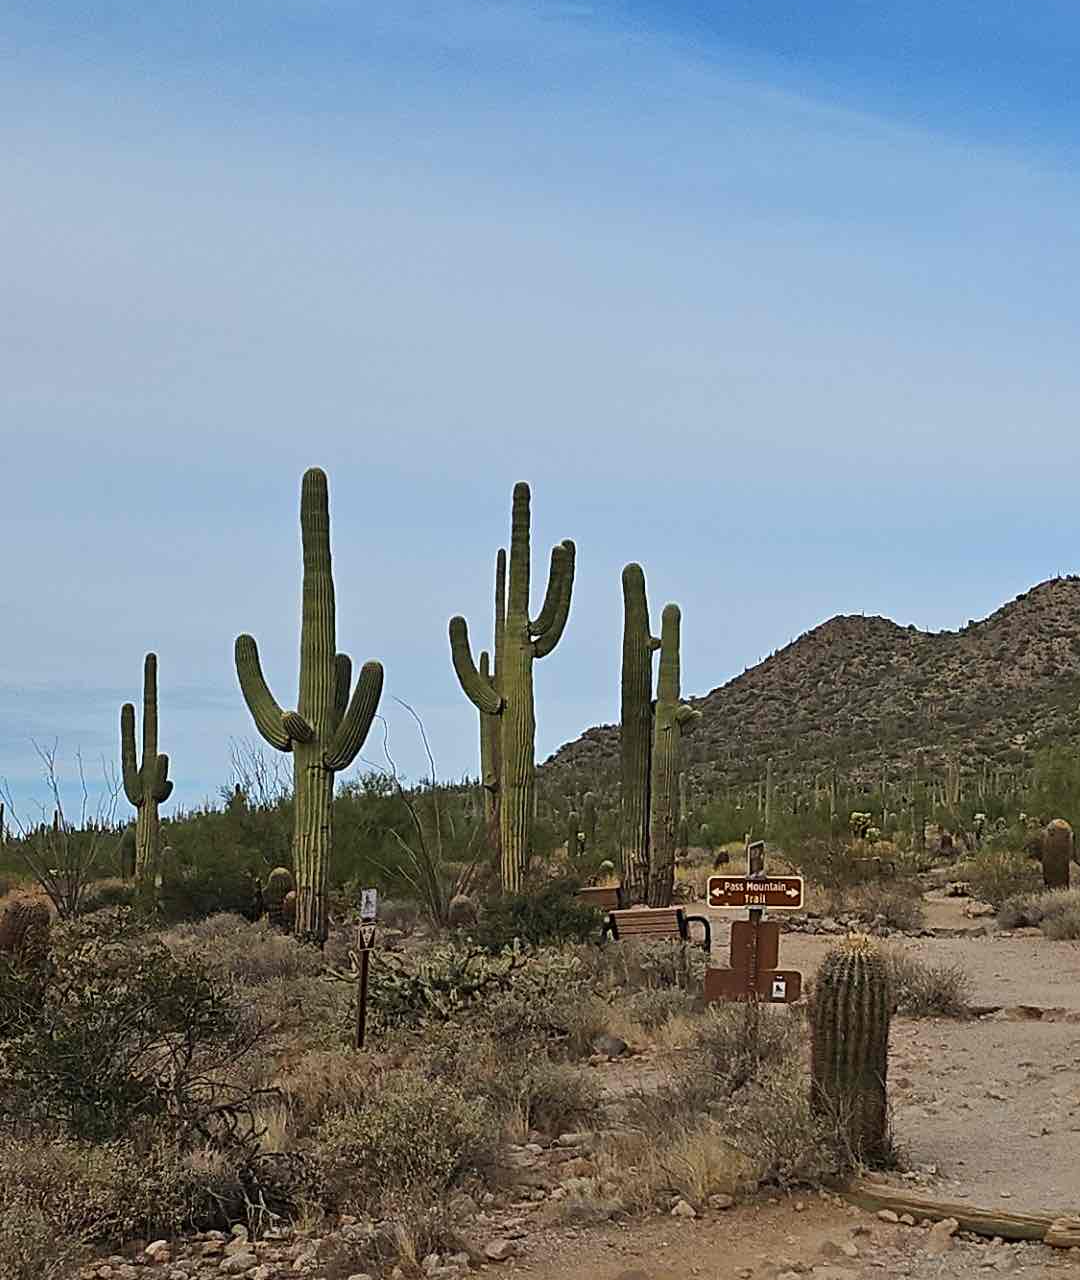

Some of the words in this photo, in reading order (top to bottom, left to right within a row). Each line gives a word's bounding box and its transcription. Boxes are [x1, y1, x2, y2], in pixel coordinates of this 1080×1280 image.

[724, 881, 744, 891] Pass
[746, 881, 787, 891] Mountain
[744, 894, 766, 904] Trail
